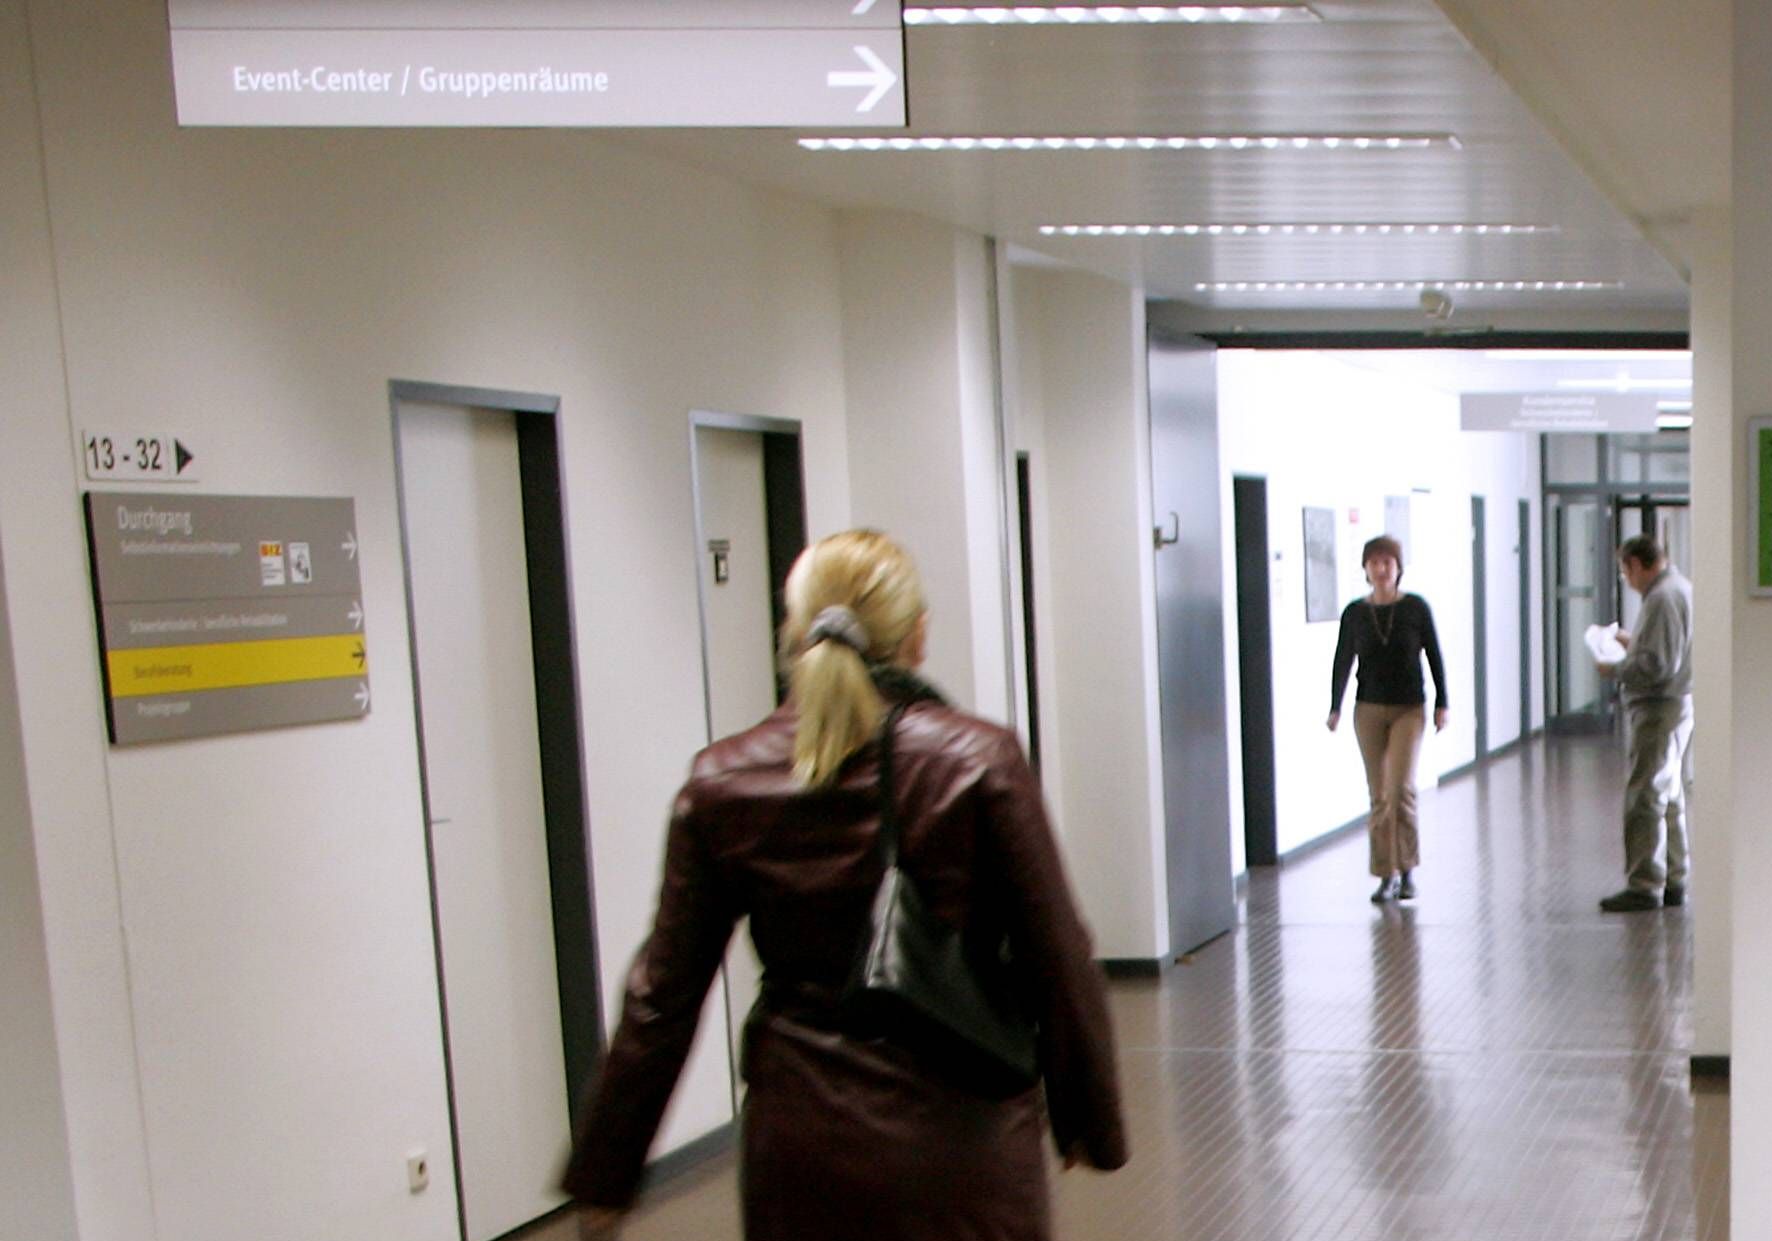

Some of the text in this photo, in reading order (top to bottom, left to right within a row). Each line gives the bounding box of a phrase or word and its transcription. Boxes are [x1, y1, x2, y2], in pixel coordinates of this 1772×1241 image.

[233, 65, 610, 97] Event-Center / Gruppenräume
[89, 438, 116, 470] 13
[136, 438, 163, 470] 32
[117, 506, 193, 535] Durchgang
